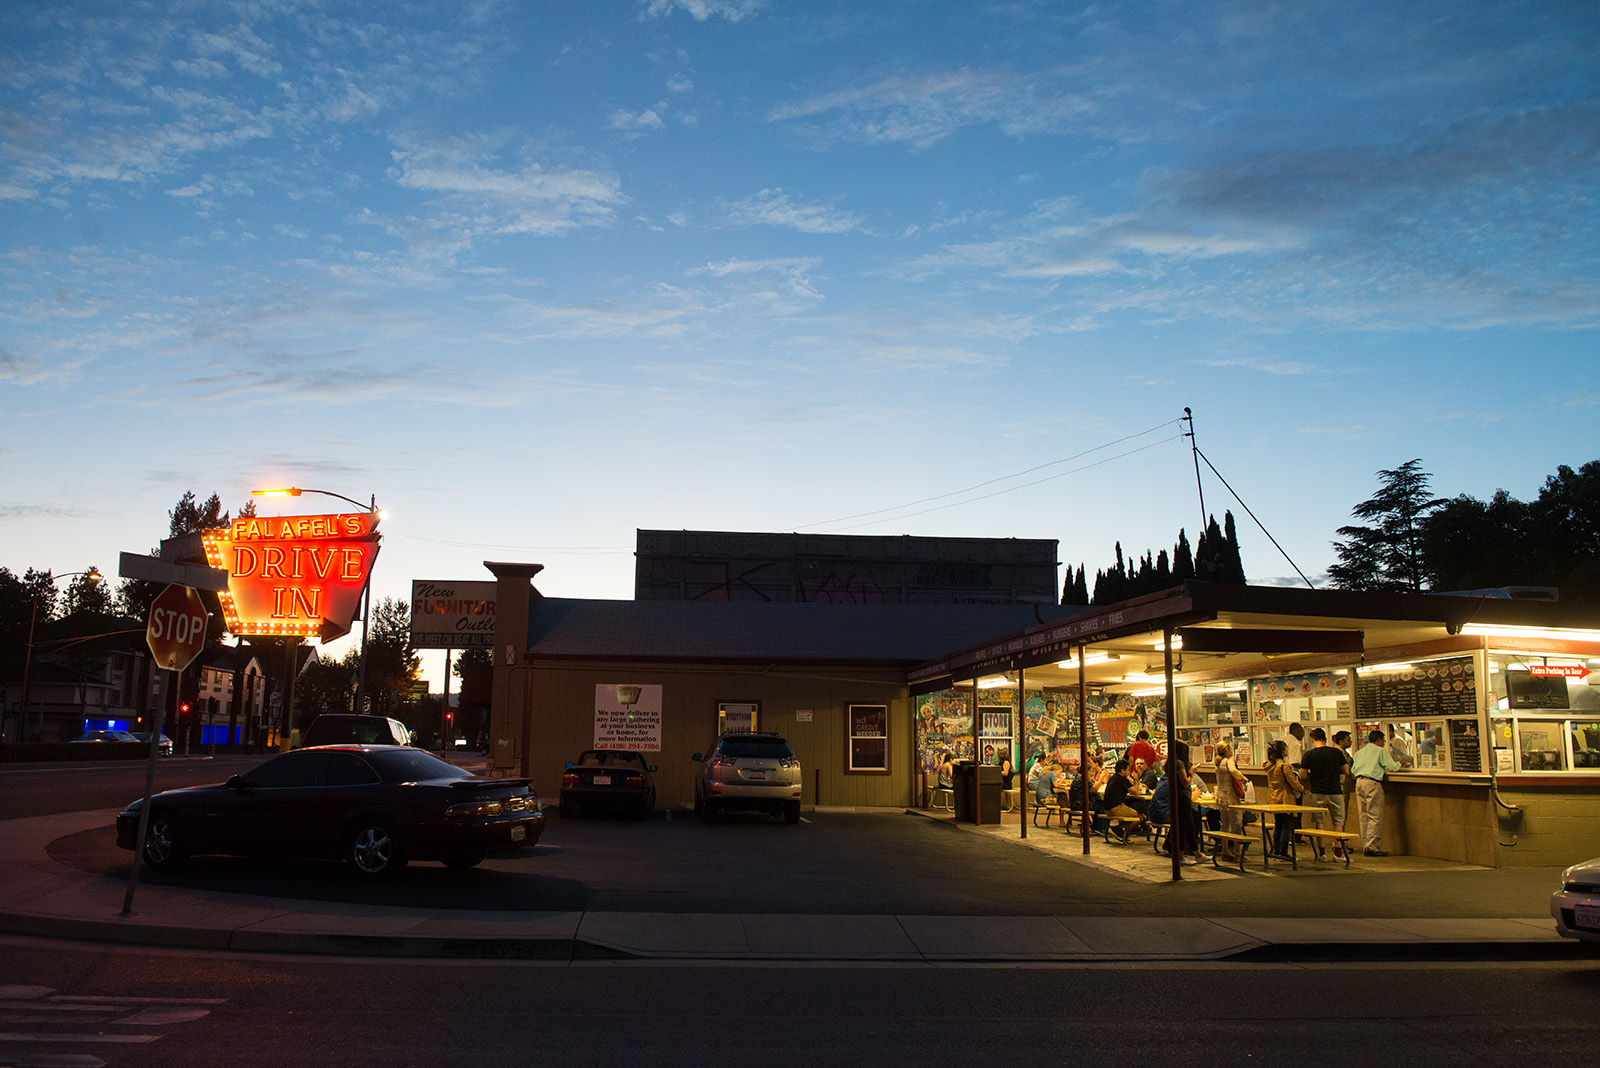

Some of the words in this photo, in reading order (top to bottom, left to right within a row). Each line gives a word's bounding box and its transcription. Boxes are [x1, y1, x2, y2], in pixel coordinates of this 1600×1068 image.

[233, 514, 361, 540] FALAFEL'S
[232, 546, 364, 579] DRIVE
[416, 583, 455, 598] New
[271, 587, 322, 619] IN
[151, 607, 203, 645] STOP
[1080, 619, 1098, 633] SHAKES
[1109, 612, 1123, 626] FRIES
[424, 634, 442, 645] MEET
[443, 634, 452, 645] OR
[454, 634, 470, 645] BEAT
[471, 634, 482, 645] ALL
[1545, 667, 1565, 676] Parking
[856, 717, 866, 725] NO
[984, 714, 1008, 728] STORE
[1099, 720, 1129, 732] DRIVE
[1109, 731, 1123, 743] IN
